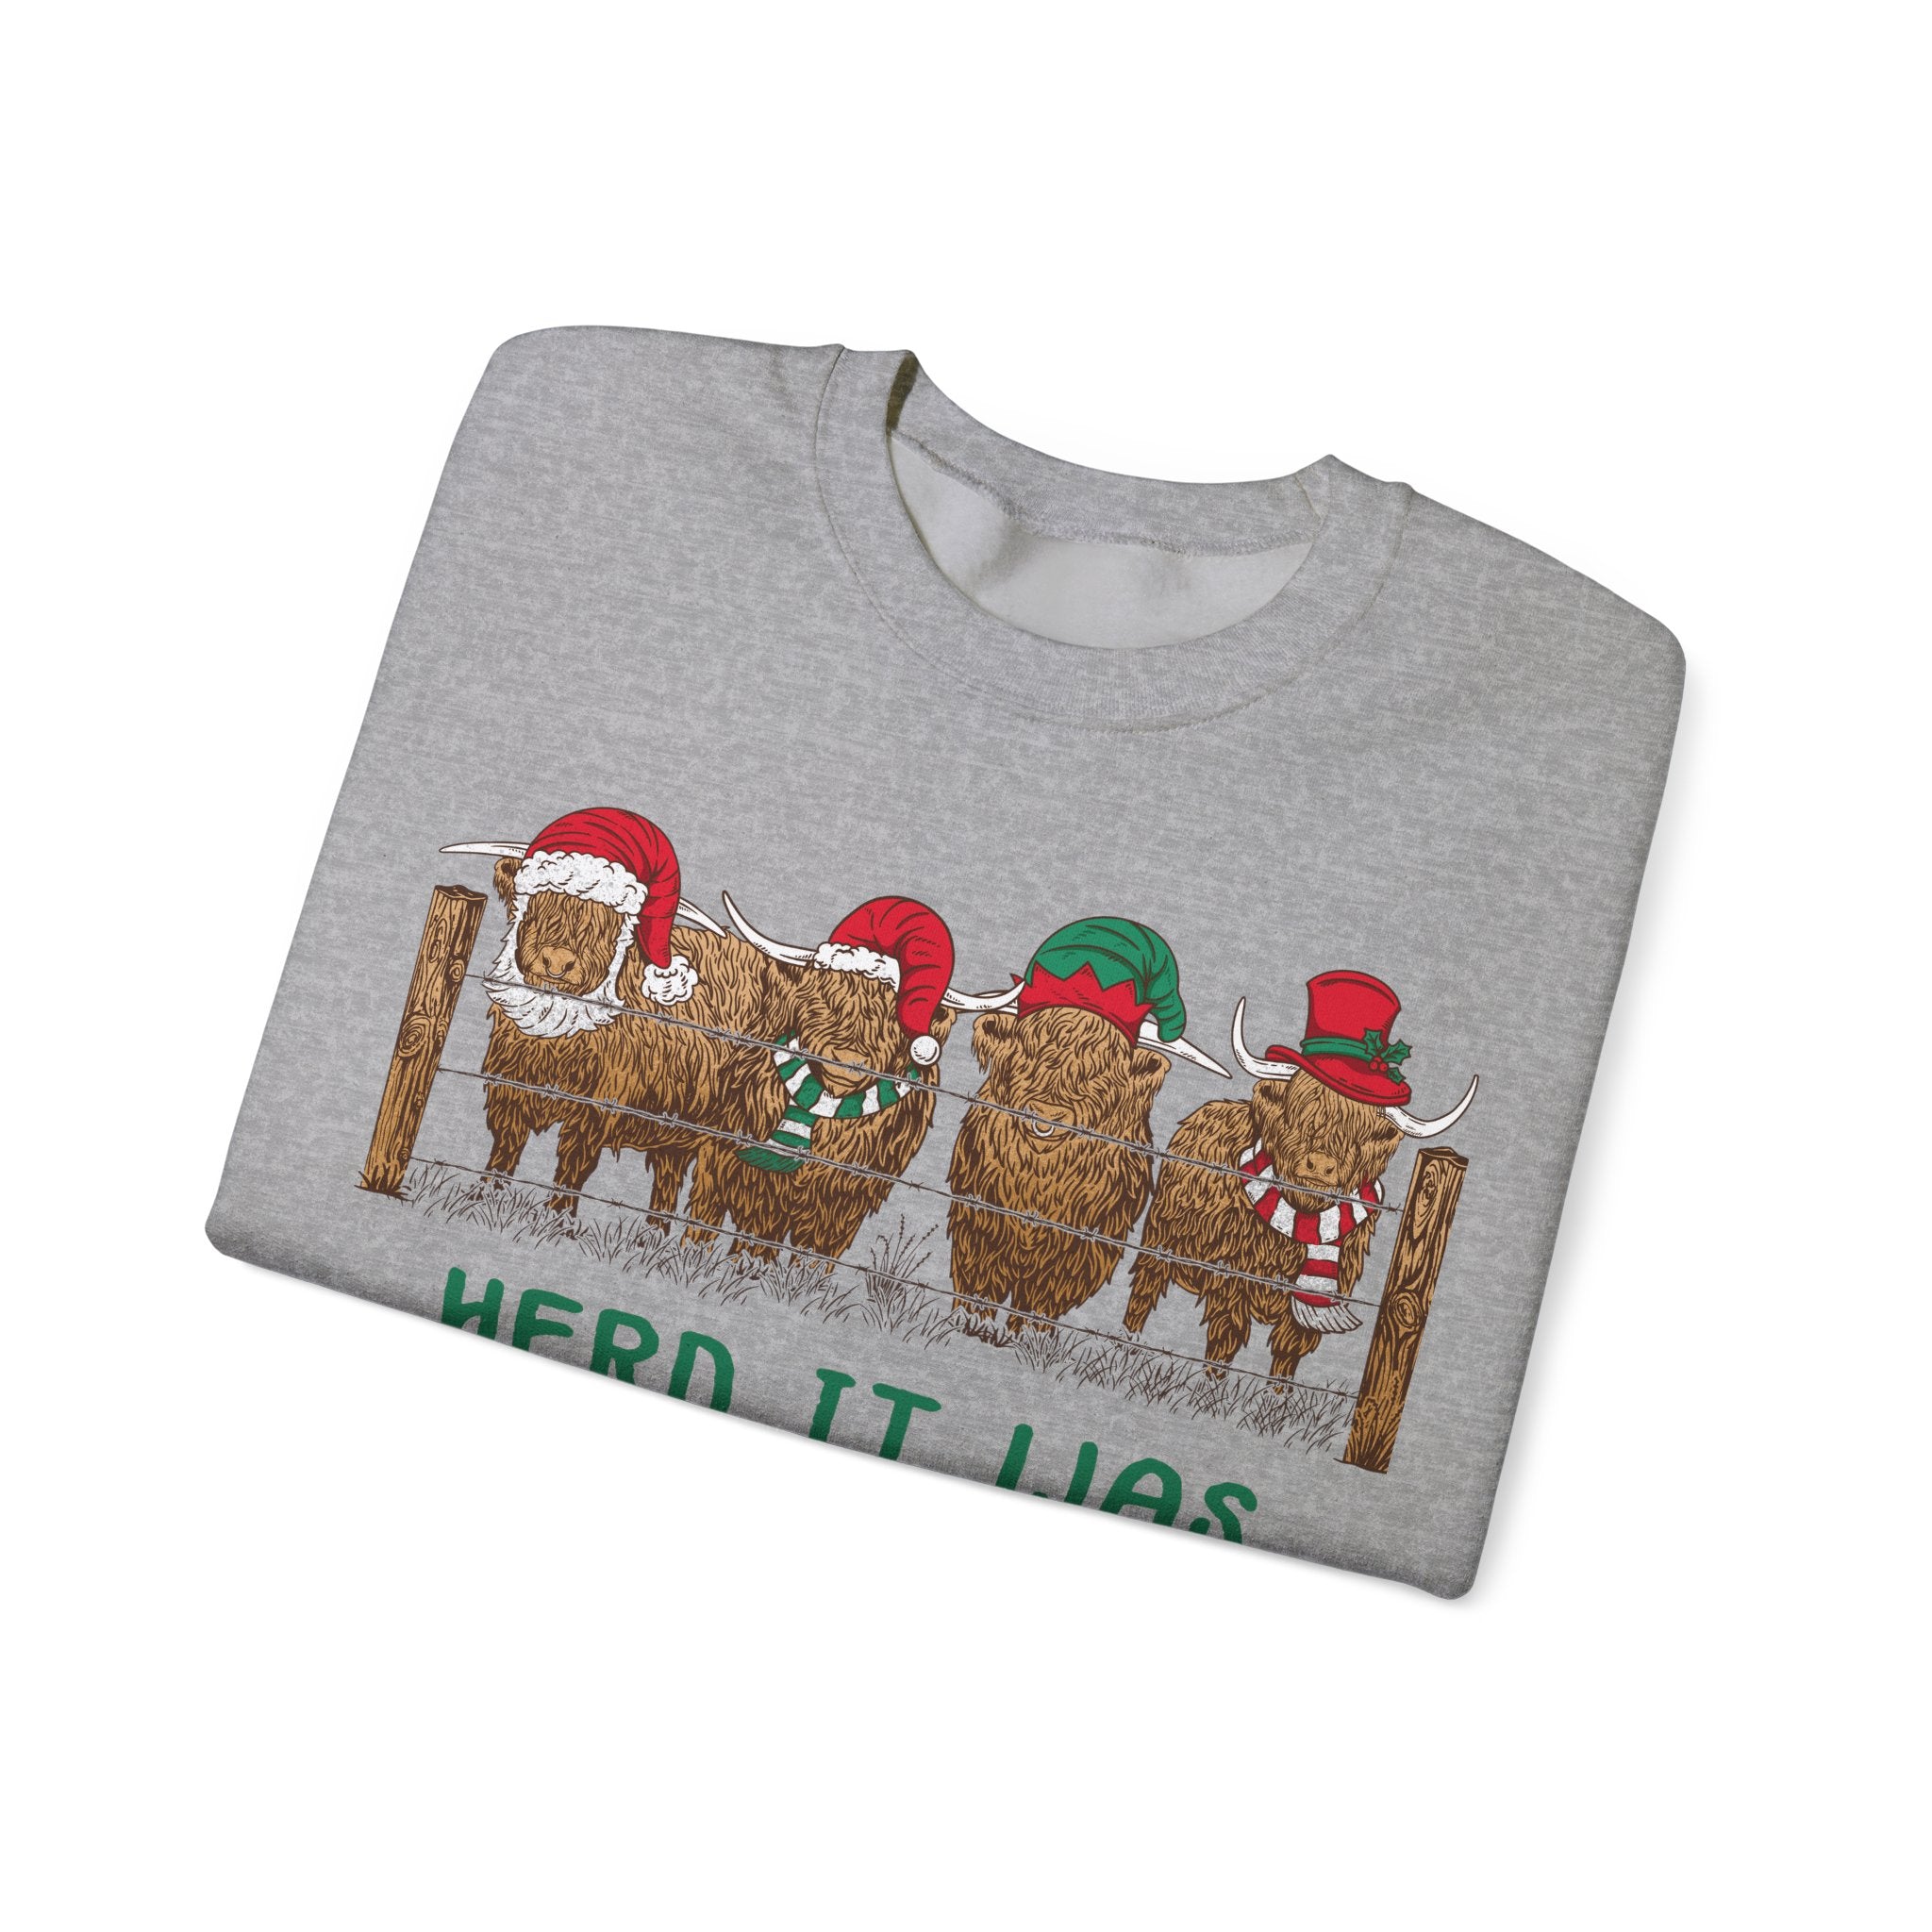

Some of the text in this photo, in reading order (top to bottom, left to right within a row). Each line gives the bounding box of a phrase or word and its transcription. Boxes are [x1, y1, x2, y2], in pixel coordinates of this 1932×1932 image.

[441, 1266, 1258, 1544] HERD IT WAS
